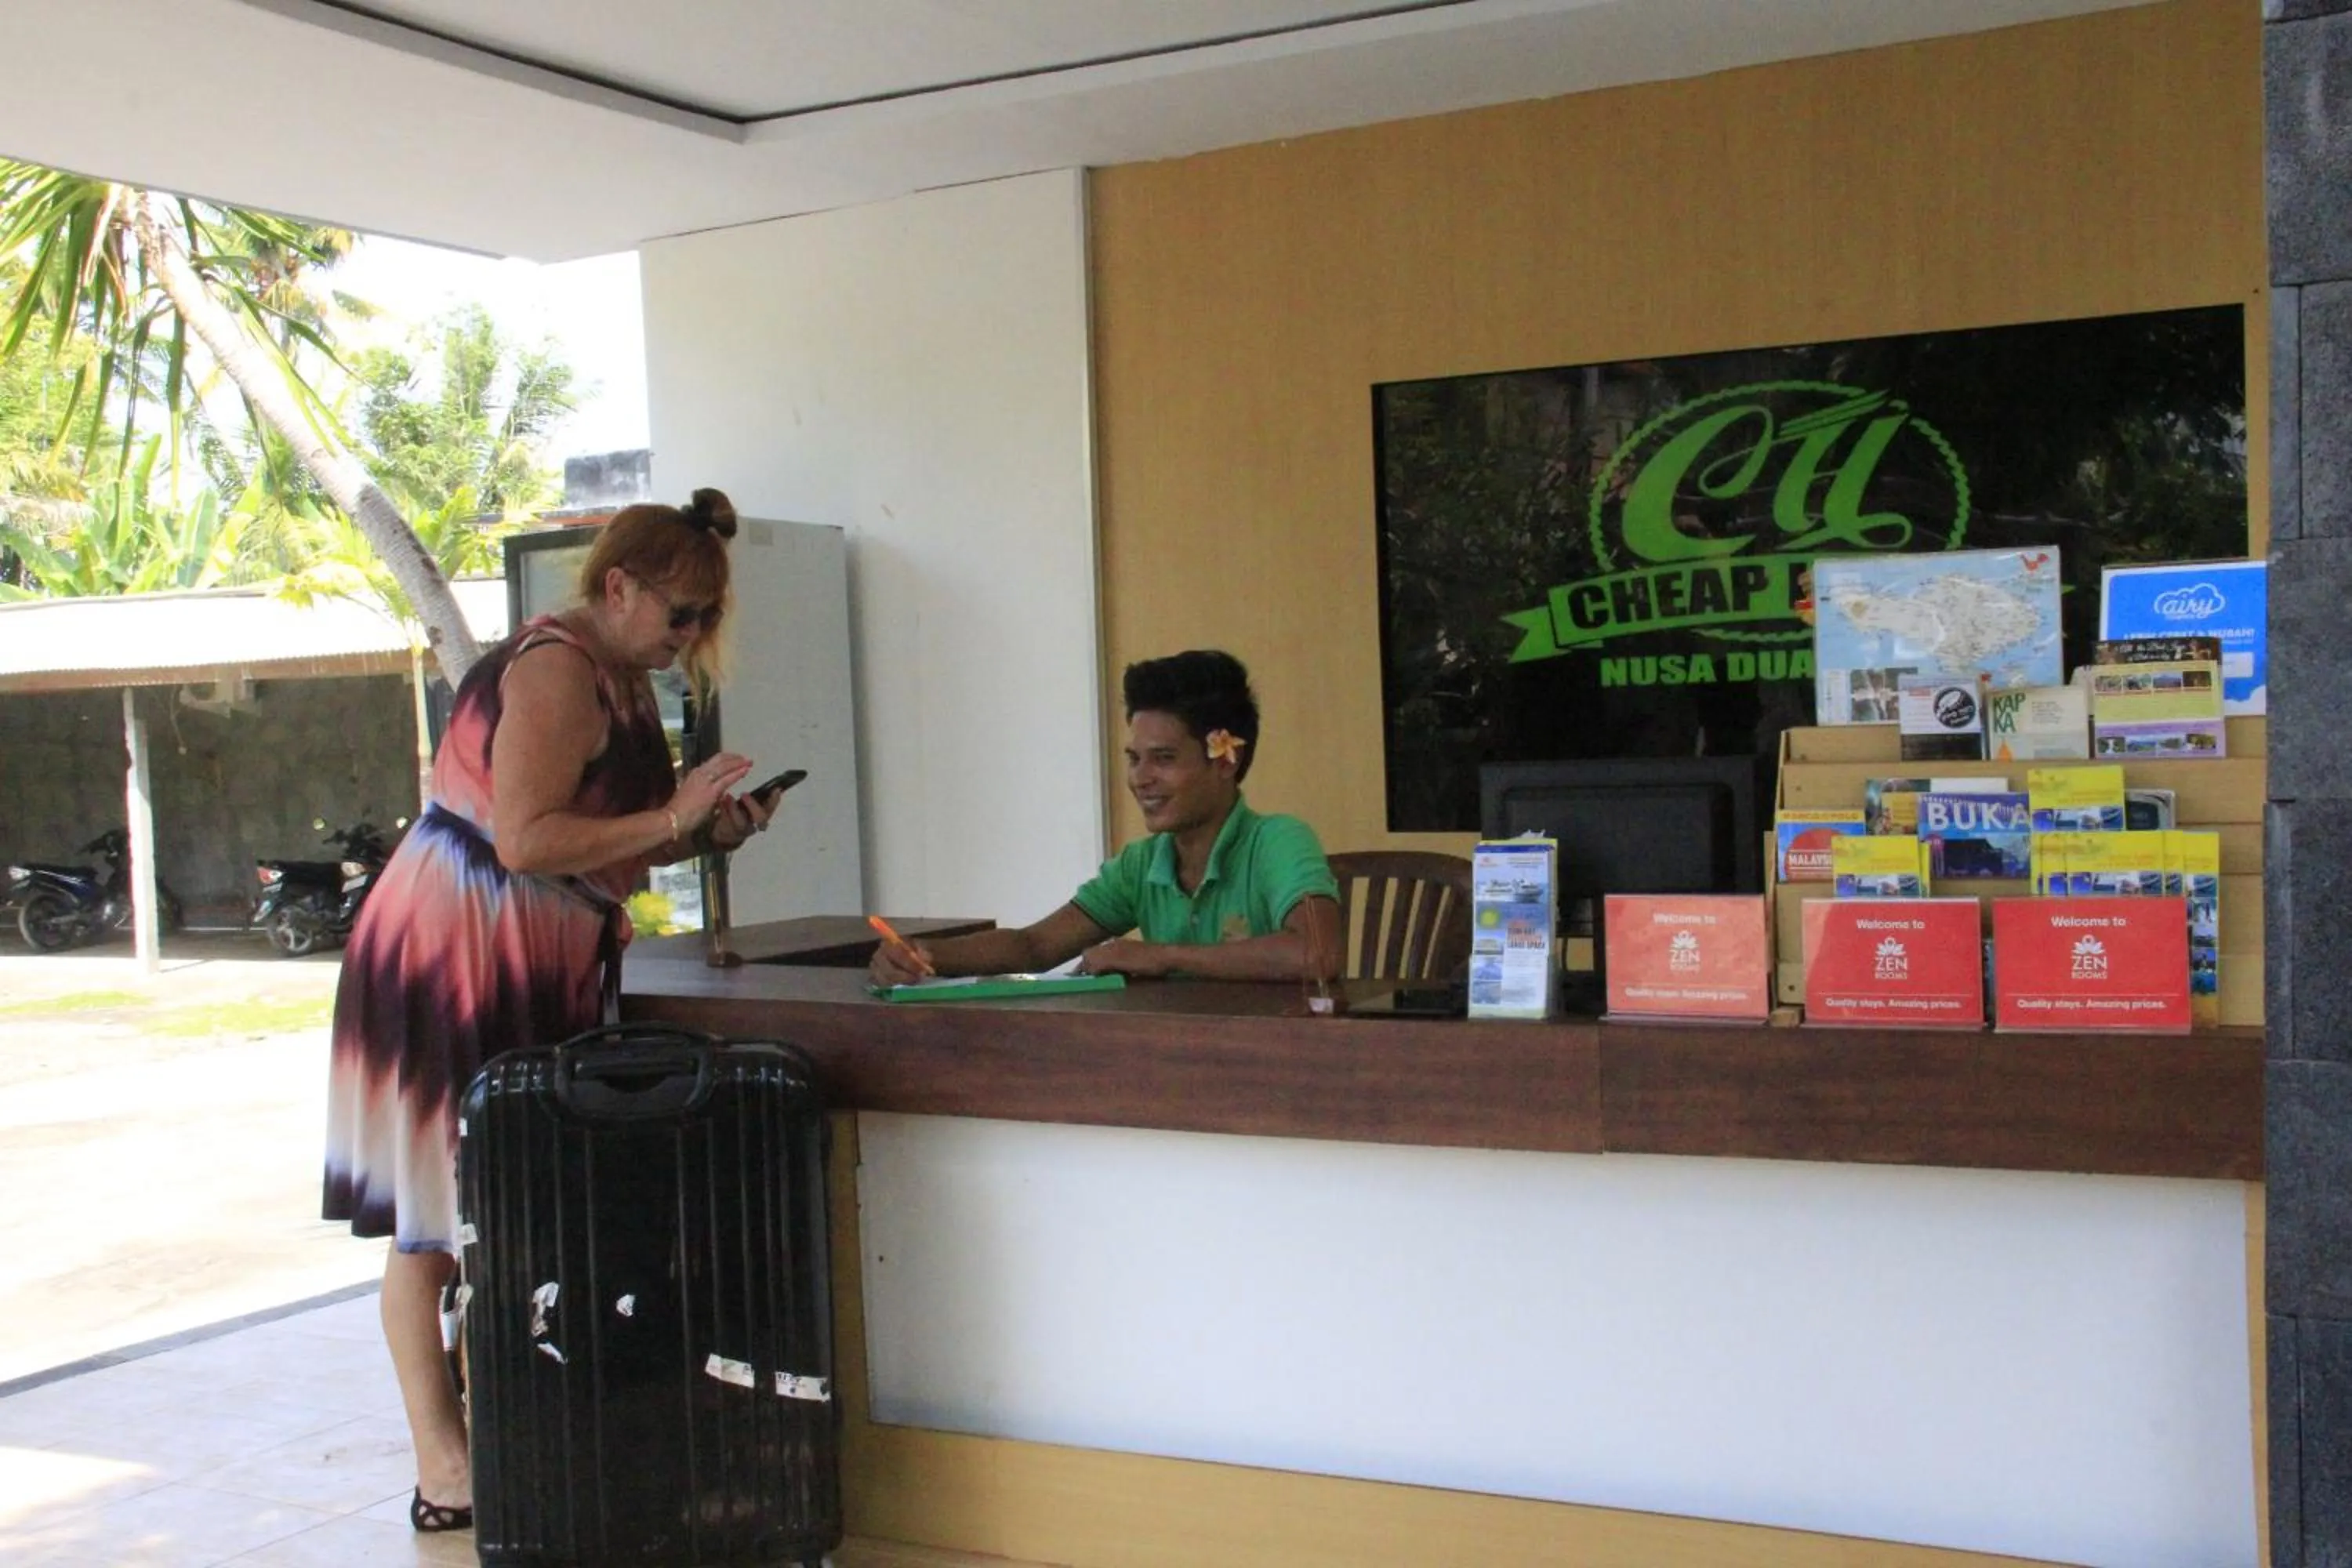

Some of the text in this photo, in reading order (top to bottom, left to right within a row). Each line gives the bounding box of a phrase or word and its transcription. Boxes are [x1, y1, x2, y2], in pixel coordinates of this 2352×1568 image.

[1570, 564, 1769, 630] CHEAP
[2162, 593, 2214, 619] airy
[1600, 649, 1816, 688] NUSA DUA
[1993, 692, 2027, 713] KAP
[1994, 712, 2016, 733] KA
[1926, 801, 2030, 830] BUKA
[1857, 919, 1926, 929] Welcome to
[2051, 916, 2126, 927] Welcome to
[1669, 949, 1700, 963] ZEN
[1875, 956, 1907, 971] ZEN
[2071, 956, 2107, 970] ZEN
[1825, 997, 1857, 1007] Quality
[1888, 998, 1928, 1009] Amazing
[2017, 999, 2052, 1010] Quality
[2086, 1000, 2130, 1011] Amazing
[2132, 1000, 2167, 1011] prices.
